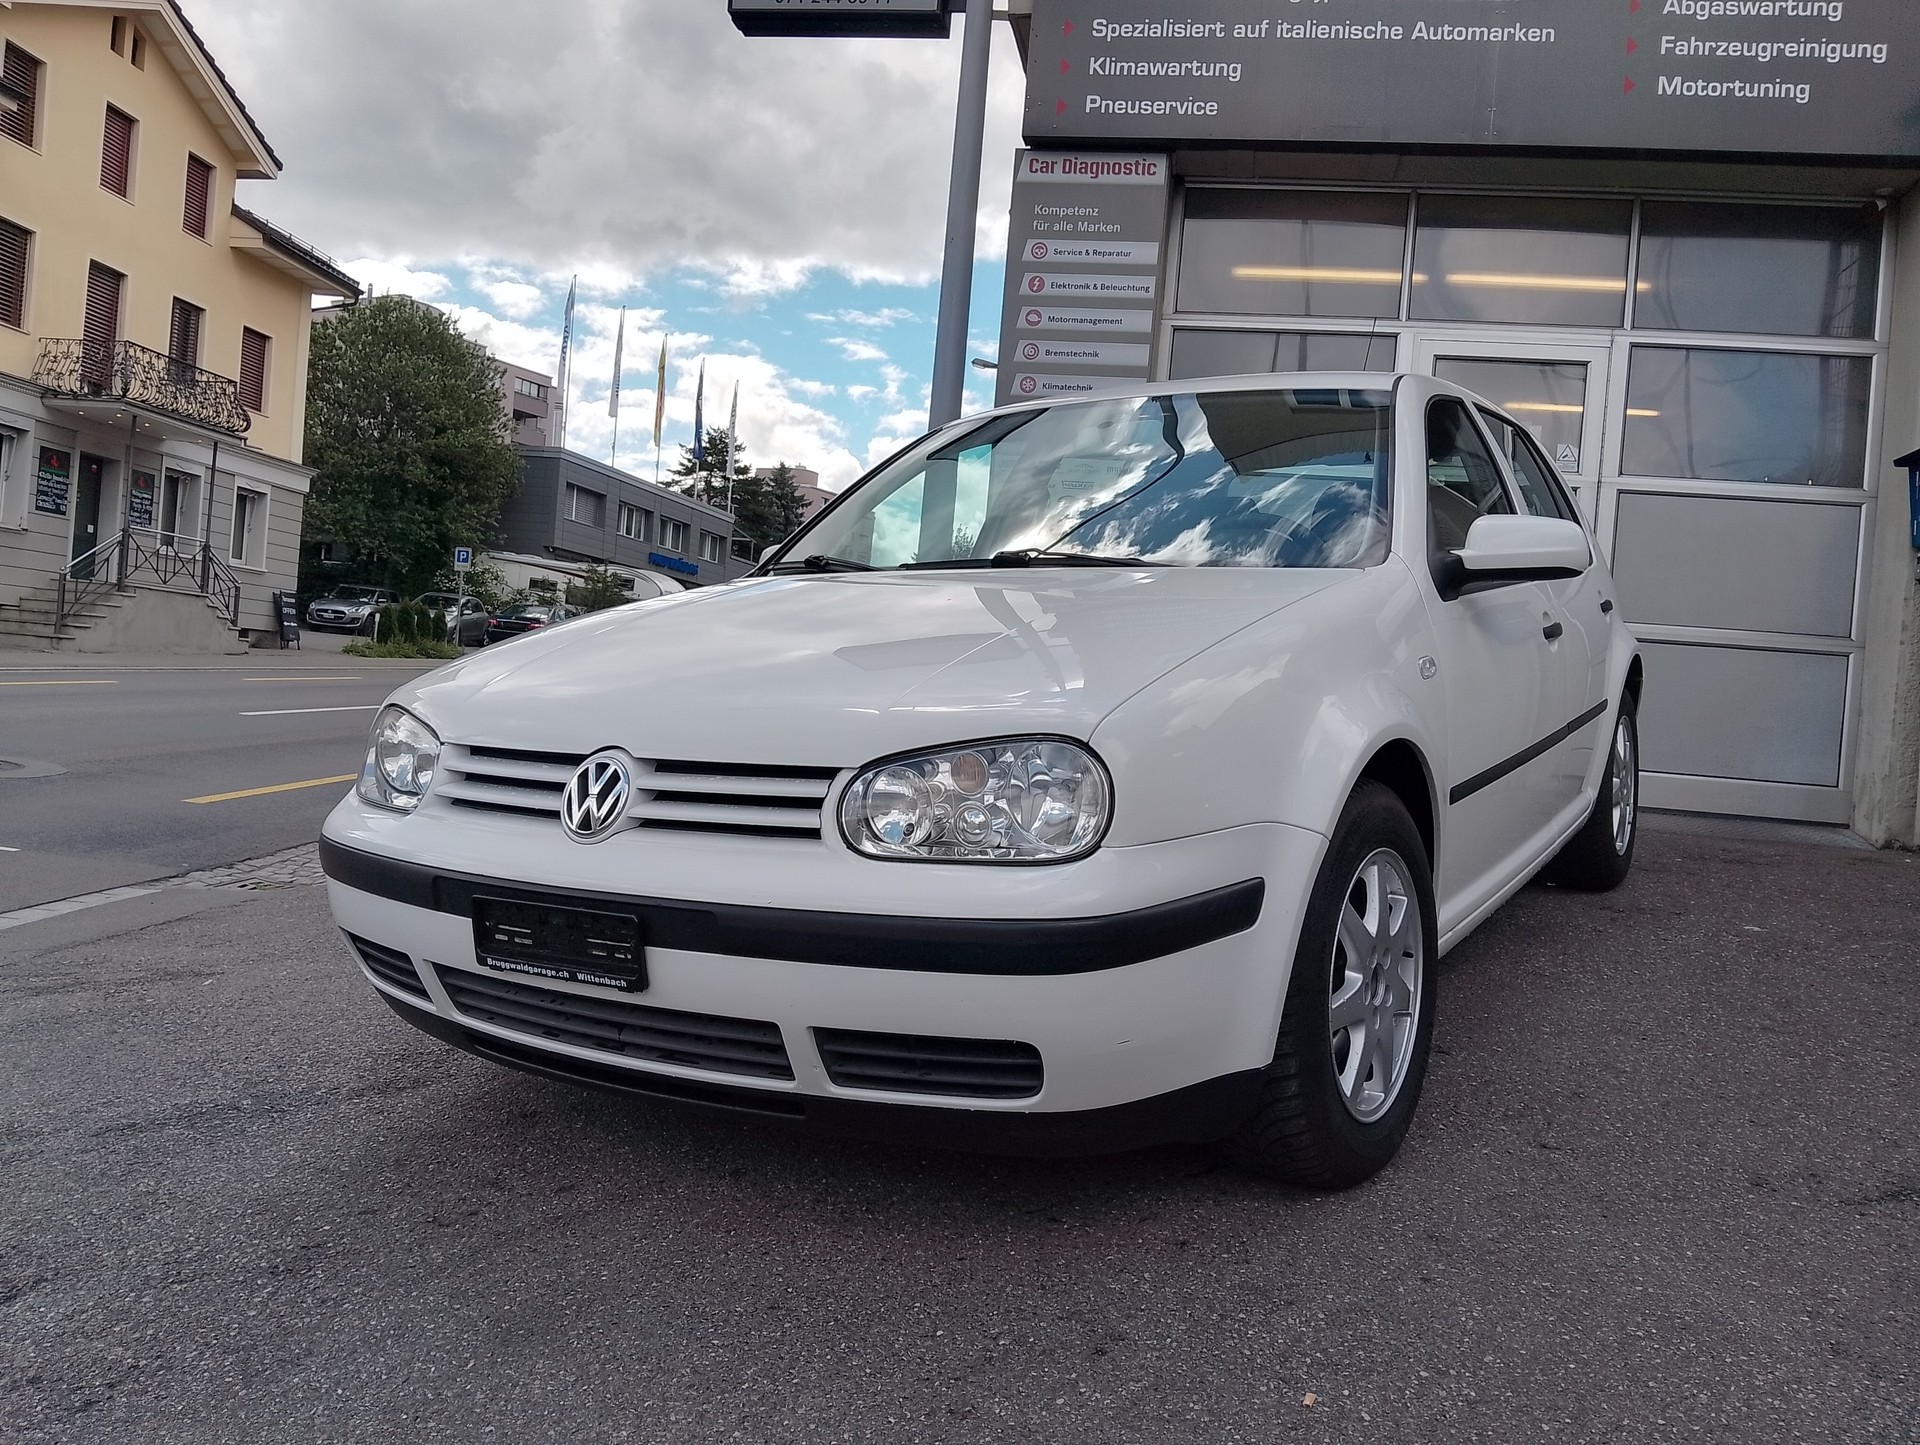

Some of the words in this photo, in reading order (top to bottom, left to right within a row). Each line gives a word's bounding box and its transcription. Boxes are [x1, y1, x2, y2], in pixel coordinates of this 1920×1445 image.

[1662, 0, 1843, 21] Abgaswartung
[1091, 18, 1226, 42] Spezialisiert
[1232, 19, 1270, 38] auf
[1276, 19, 1404, 41] italienische
[1411, 21, 1556, 43] Automarken
[1660, 36, 1888, 63] Fahrzeugreinigung
[1088, 56, 1243, 82] Klimawartung
[1657, 76, 1811, 103] Motortuning
[1084, 94, 1219, 116] Pneuservice
[1029, 157, 1057, 174] Car
[1062, 157, 1157, 179] Diagnostic
[1034, 204, 1099, 219] Kompetenz
[1033, 220, 1050, 231] für
[1053, 221, 1073, 232] alle
[1077, 223, 1121, 233] Marken
[1053, 248, 1083, 256] Service
[1092, 250, 1132, 259] Reparatur
[1050, 281, 1091, 291] Elektronik
[1092, 283, 1098, 291] &
[1100, 283, 1151, 294] Beleuchtung
[1048, 315, 1123, 326] Motormanagement
[1045, 349, 1100, 359] Bremstechnik
[1042, 382, 1094, 392] Klimatechnik
[487, 957, 570, 979] Bruggwaldgarage.ch
[576, 972, 627, 988] Wittenbach
